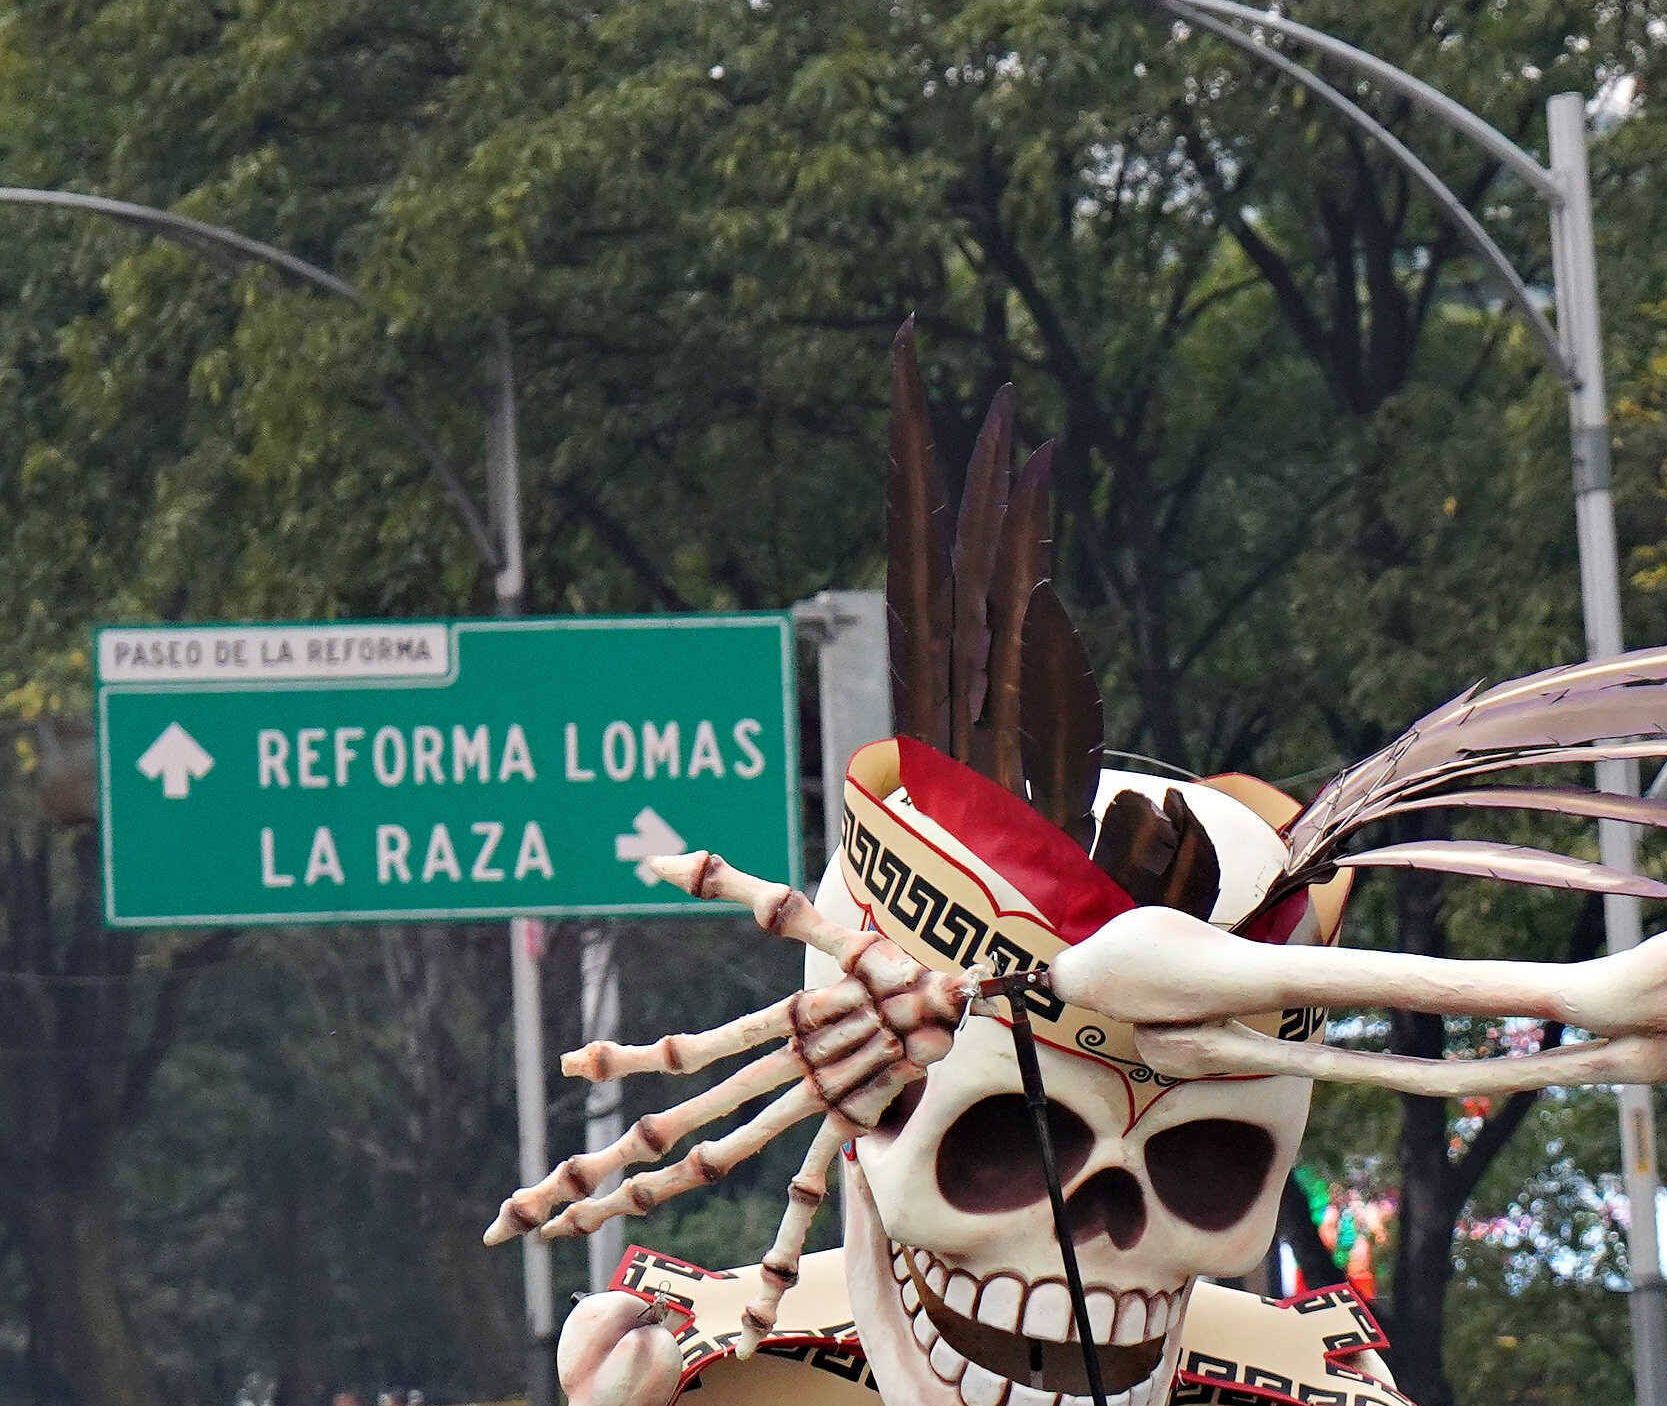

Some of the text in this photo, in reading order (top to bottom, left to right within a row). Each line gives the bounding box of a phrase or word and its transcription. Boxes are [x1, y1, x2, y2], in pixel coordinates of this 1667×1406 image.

[114, 637, 432, 667] PASEO DE LA REFORMA
[257, 718, 765, 788] REFORMA LOMAS
[259, 820, 555, 887] LA RAZA
